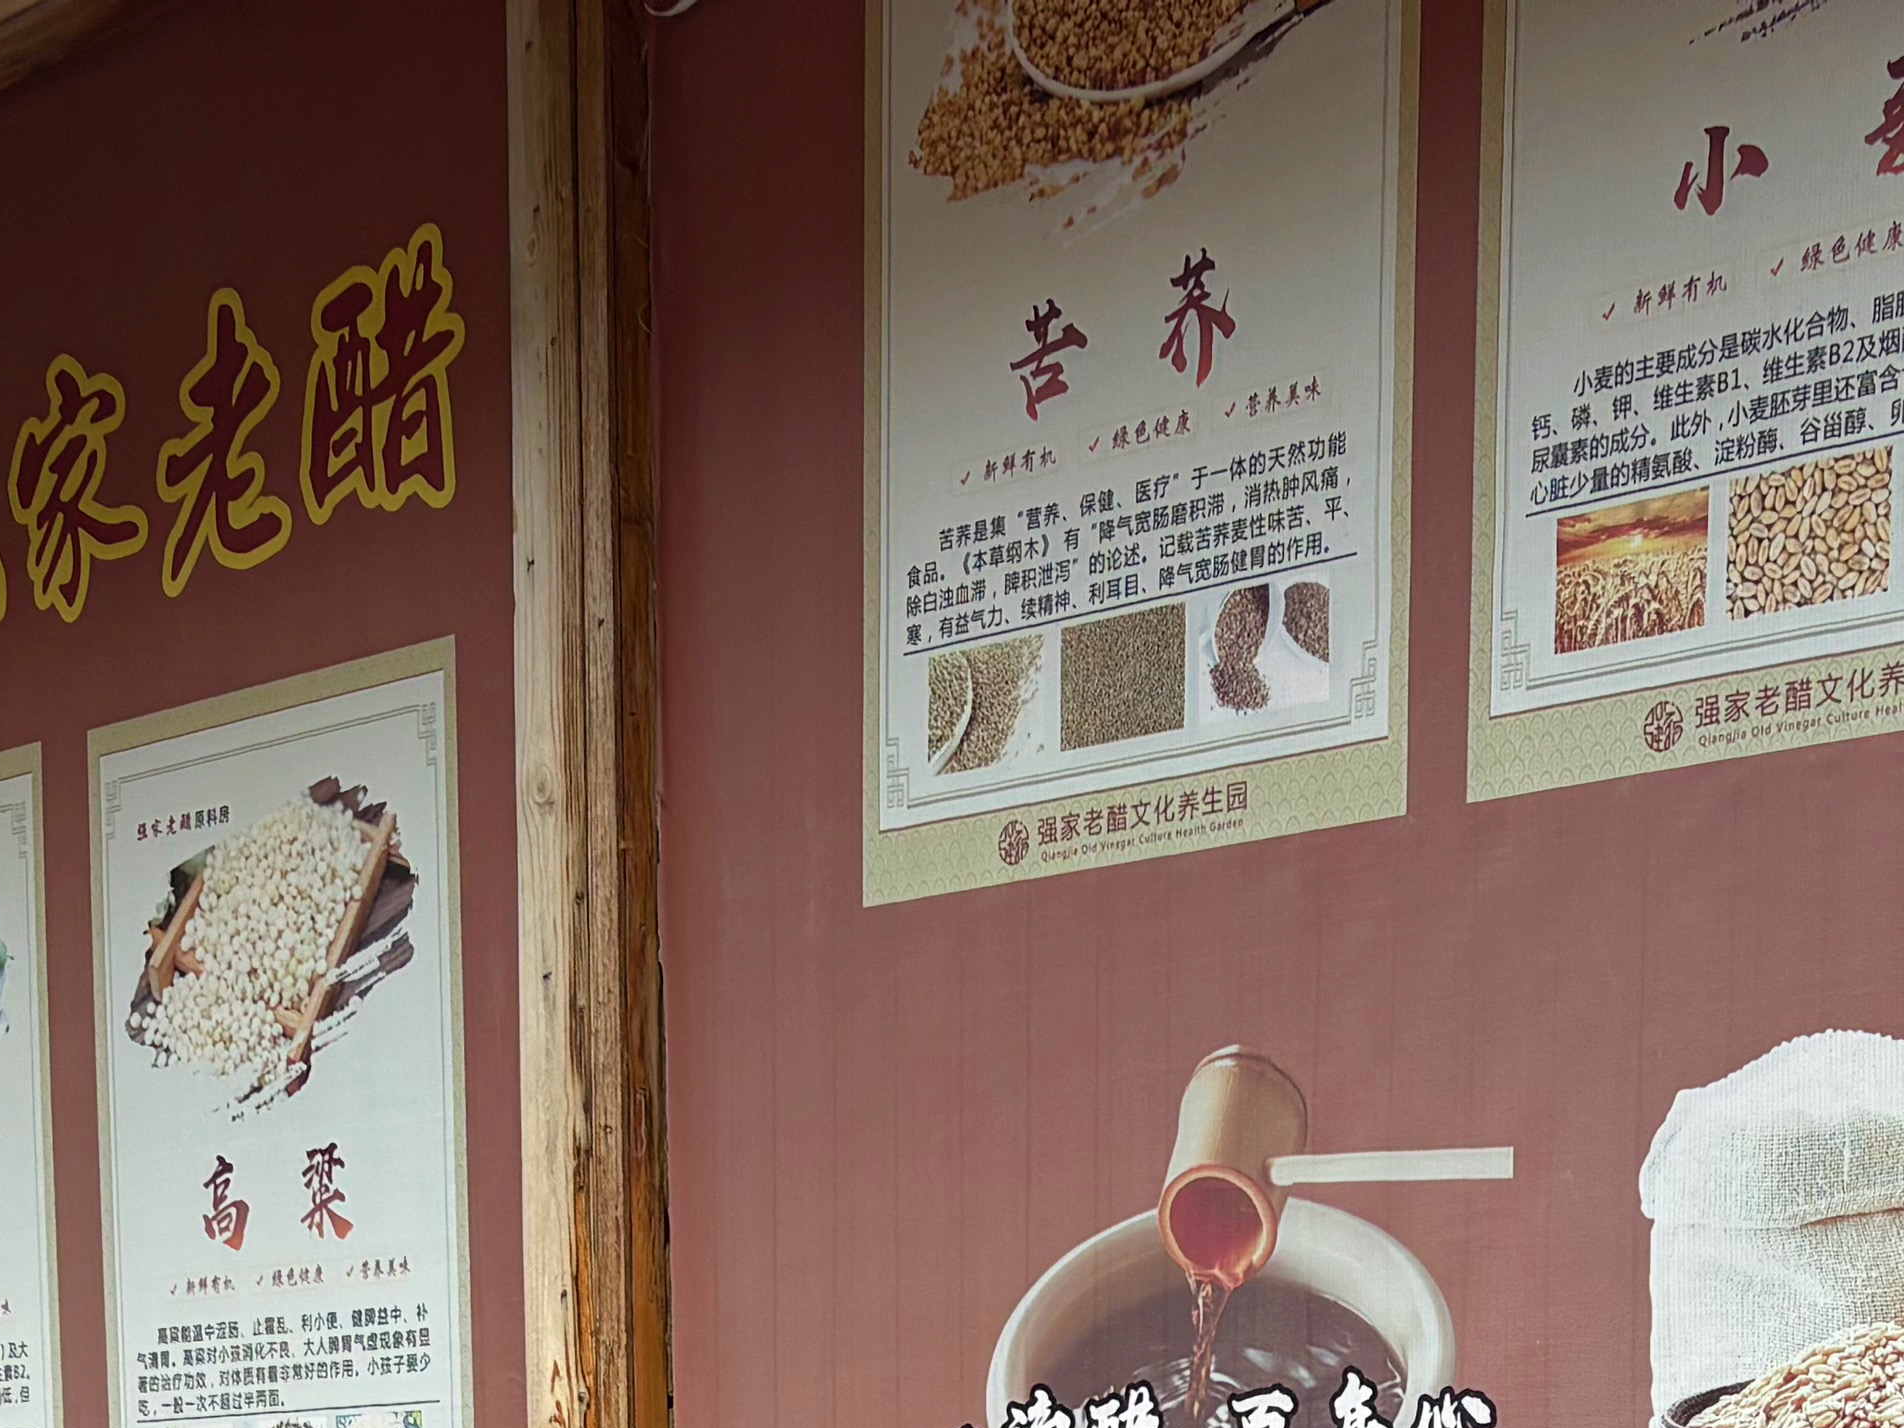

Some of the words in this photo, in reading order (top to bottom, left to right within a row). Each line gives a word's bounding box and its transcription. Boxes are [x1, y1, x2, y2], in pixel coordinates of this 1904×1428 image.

[1633, 271, 1729, 316] 新鲜有机
[1799, 220, 1904, 274] 绿色健康
[1009, 246, 1237, 422] 苦荞
[983, 449, 1057, 483] 新鲜有机
[1111, 408, 1192, 452] 绿色健康
[1245, 375, 1322, 418] 营养美味
[1751, 725, 1771, 738] Old
[1777, 717, 1821, 734] Vinegar
[1826, 710, 1870, 725] Culture
[1038, 781, 1247, 846] 强家老醋文化养生园
[202, 1141, 354, 1251] 高粱
